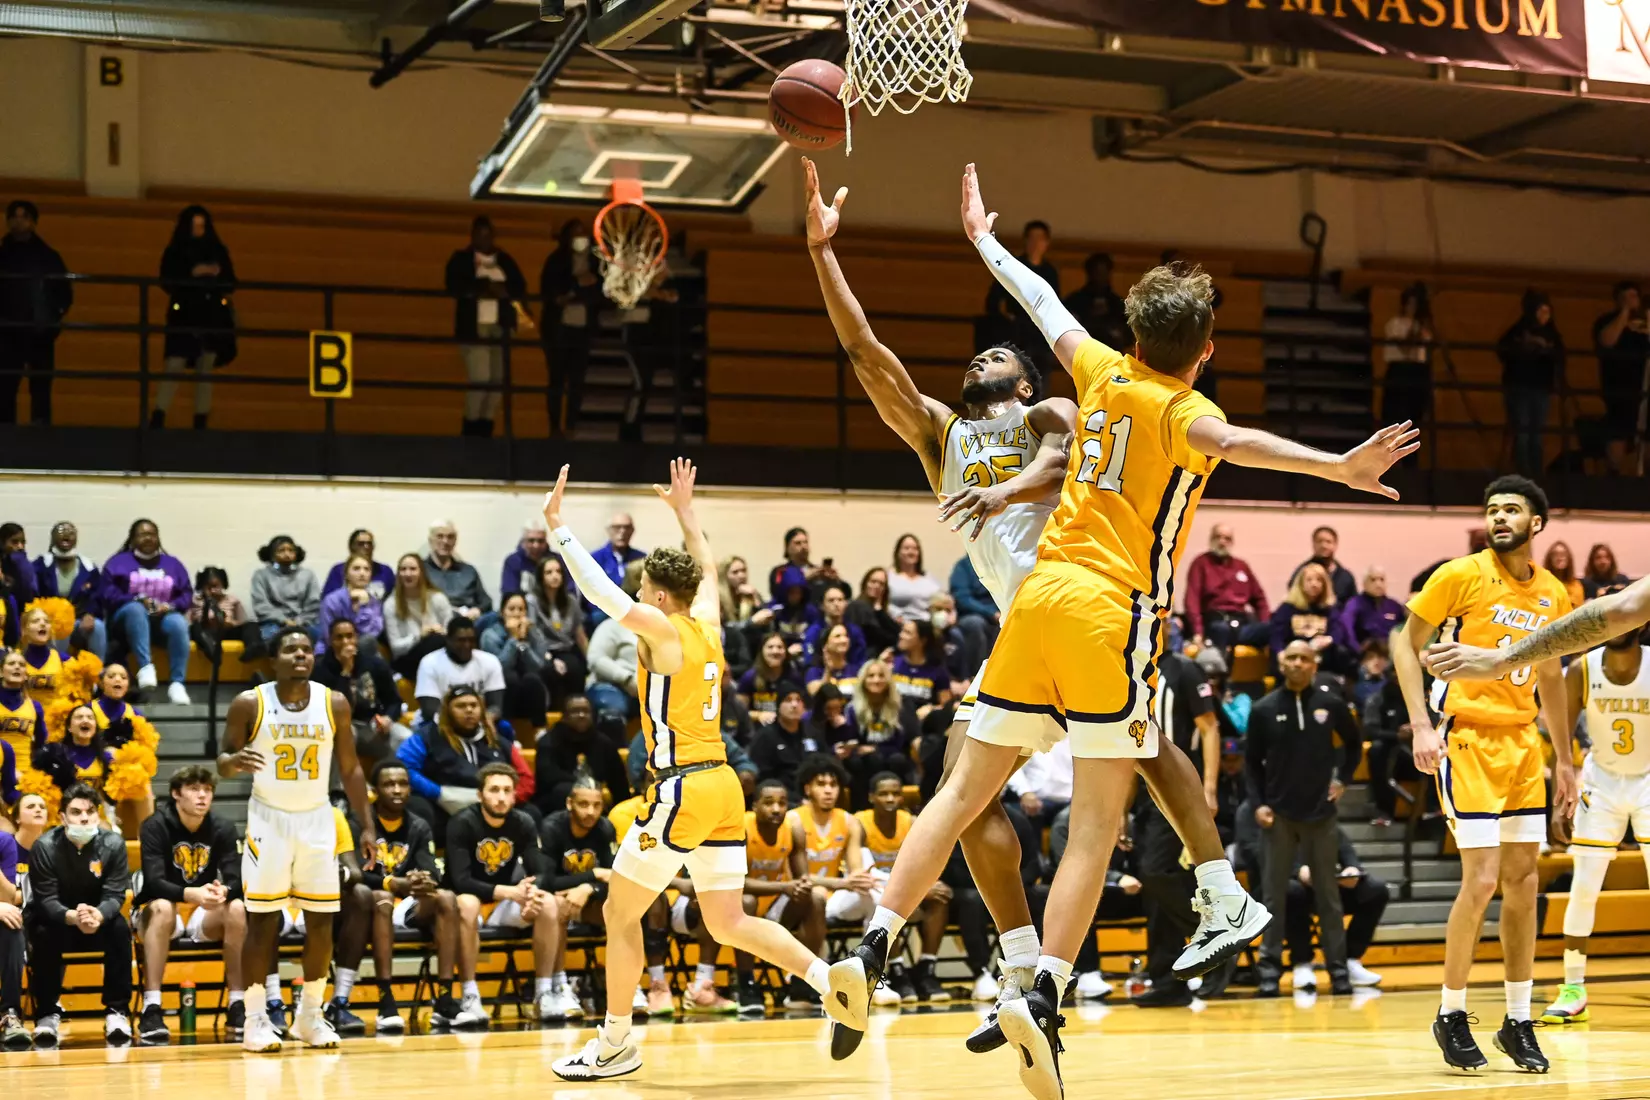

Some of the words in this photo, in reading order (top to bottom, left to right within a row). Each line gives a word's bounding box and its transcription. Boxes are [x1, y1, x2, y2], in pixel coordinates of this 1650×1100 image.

[1195, 0, 1563, 40] ASIUM
[100, 57, 122, 86] B
[314, 335, 348, 393] B
[960, 424, 1028, 459] VILLE
[1075, 410, 1133, 495] 21
[1489, 604, 1549, 633] WCU
[701, 661, 720, 721] 3
[1593, 697, 1650, 715] VILLE
[268, 723, 326, 741] VILLE
[1611, 718, 1635, 755] 3
[273, 743, 319, 780] 24
